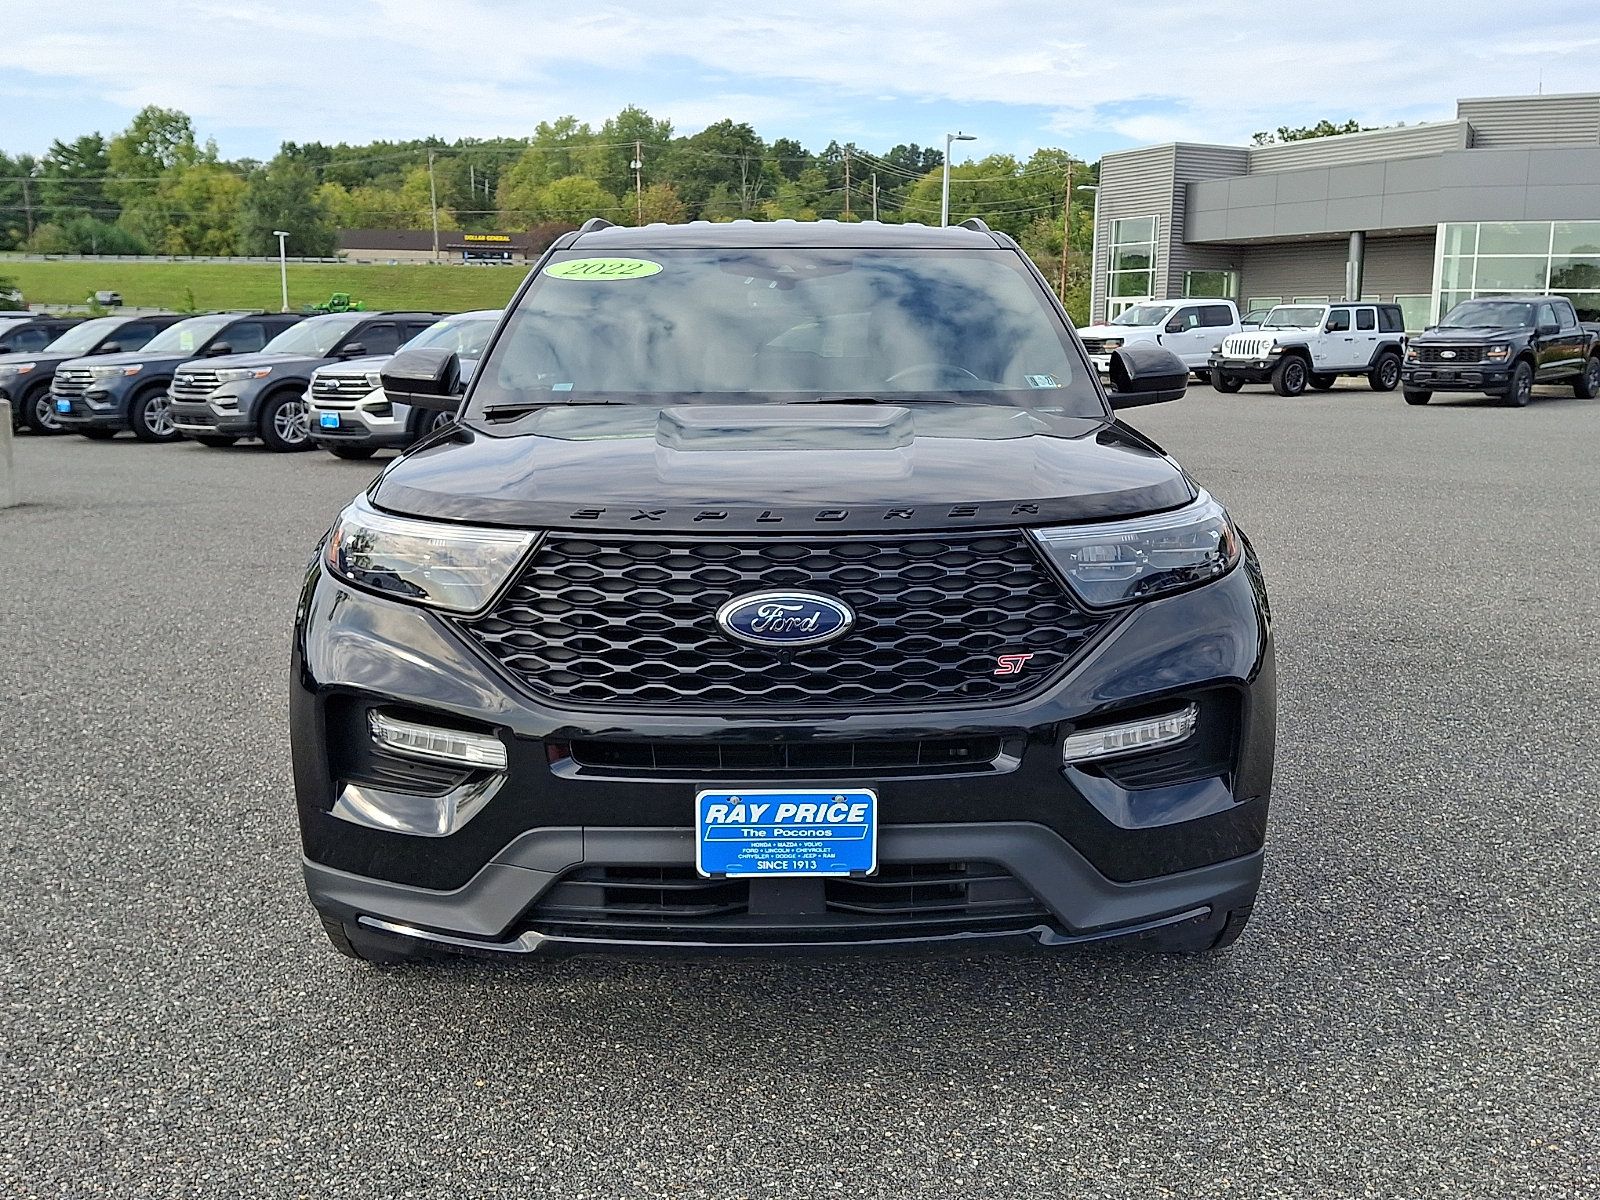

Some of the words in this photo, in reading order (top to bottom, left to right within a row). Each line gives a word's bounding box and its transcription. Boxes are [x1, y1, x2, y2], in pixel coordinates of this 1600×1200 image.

[562, 262, 644, 276] 2022
[569, 500, 1041, 523] EXPLORER
[750, 603, 822, 634] Ford
[994, 653, 1034, 675] ST
[705, 803, 770, 824] RAY
[774, 803, 869, 823] PRICE
[741, 828, 767, 838] The
[774, 828, 833, 838] Poconos
[757, 860, 788, 870] SINCE
[792, 860, 817, 870] 1913
